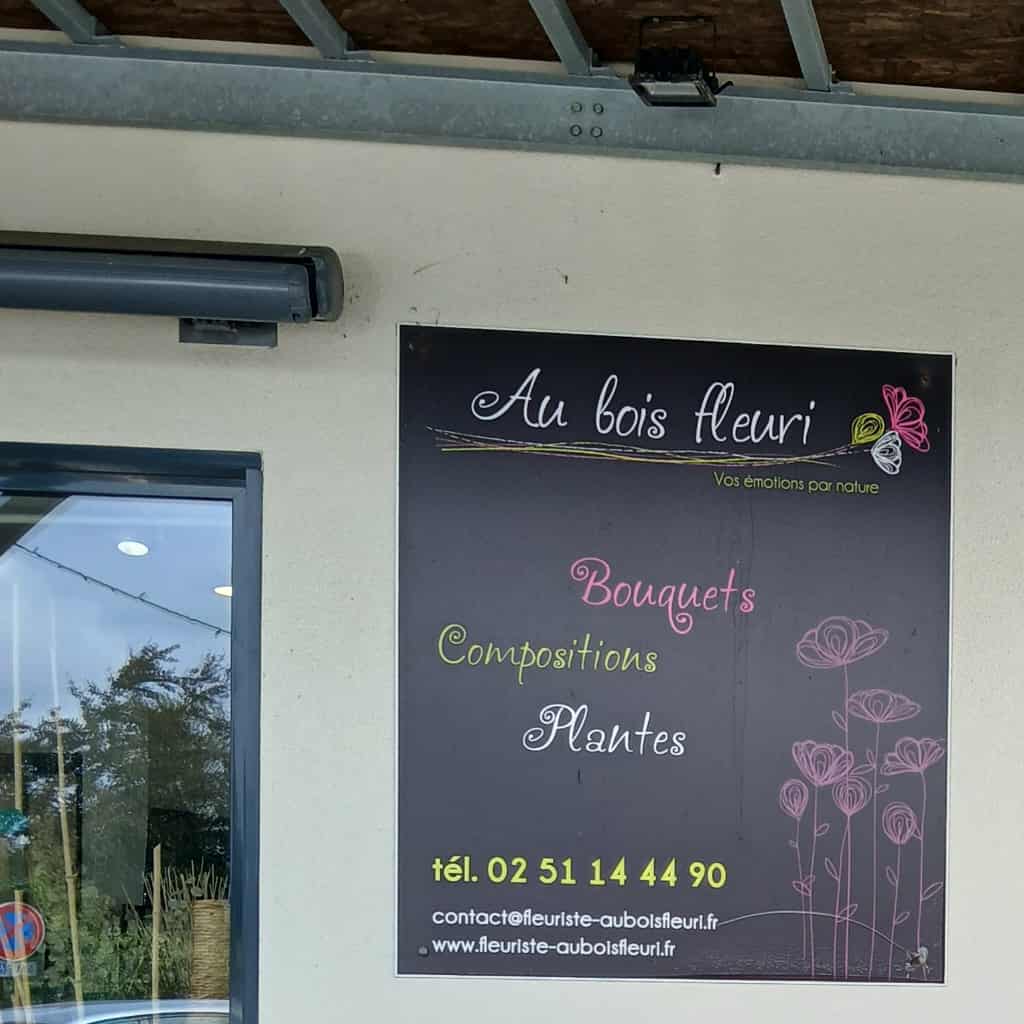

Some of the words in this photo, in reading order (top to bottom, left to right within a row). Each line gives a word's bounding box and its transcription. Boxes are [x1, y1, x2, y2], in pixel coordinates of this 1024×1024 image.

[471, 368, 567, 428] Au
[595, 374, 667, 438] bois
[695, 382, 816, 445] fleuri
[714, 472, 740, 487] Vos
[744, 475, 804, 490] émotions
[808, 480, 833, 494] par
[836, 480, 879, 494] nature
[570, 556, 756, 634] Bouquets
[438, 624, 658, 685] Compositions
[522, 704, 687, 756] Plantes
[432, 856, 479, 882] tél.
[487, 857, 528, 883] 02
[539, 858, 577, 885] 51
[589, 856, 628, 886] 14
[639, 857, 678, 887] 44
[688, 862, 727, 888] 90
[432, 909, 719, 931] contact@fleuriste-auboisfleuri.fr
[432, 936, 676, 957] www.fleuriste-auboisfleuri.fr
